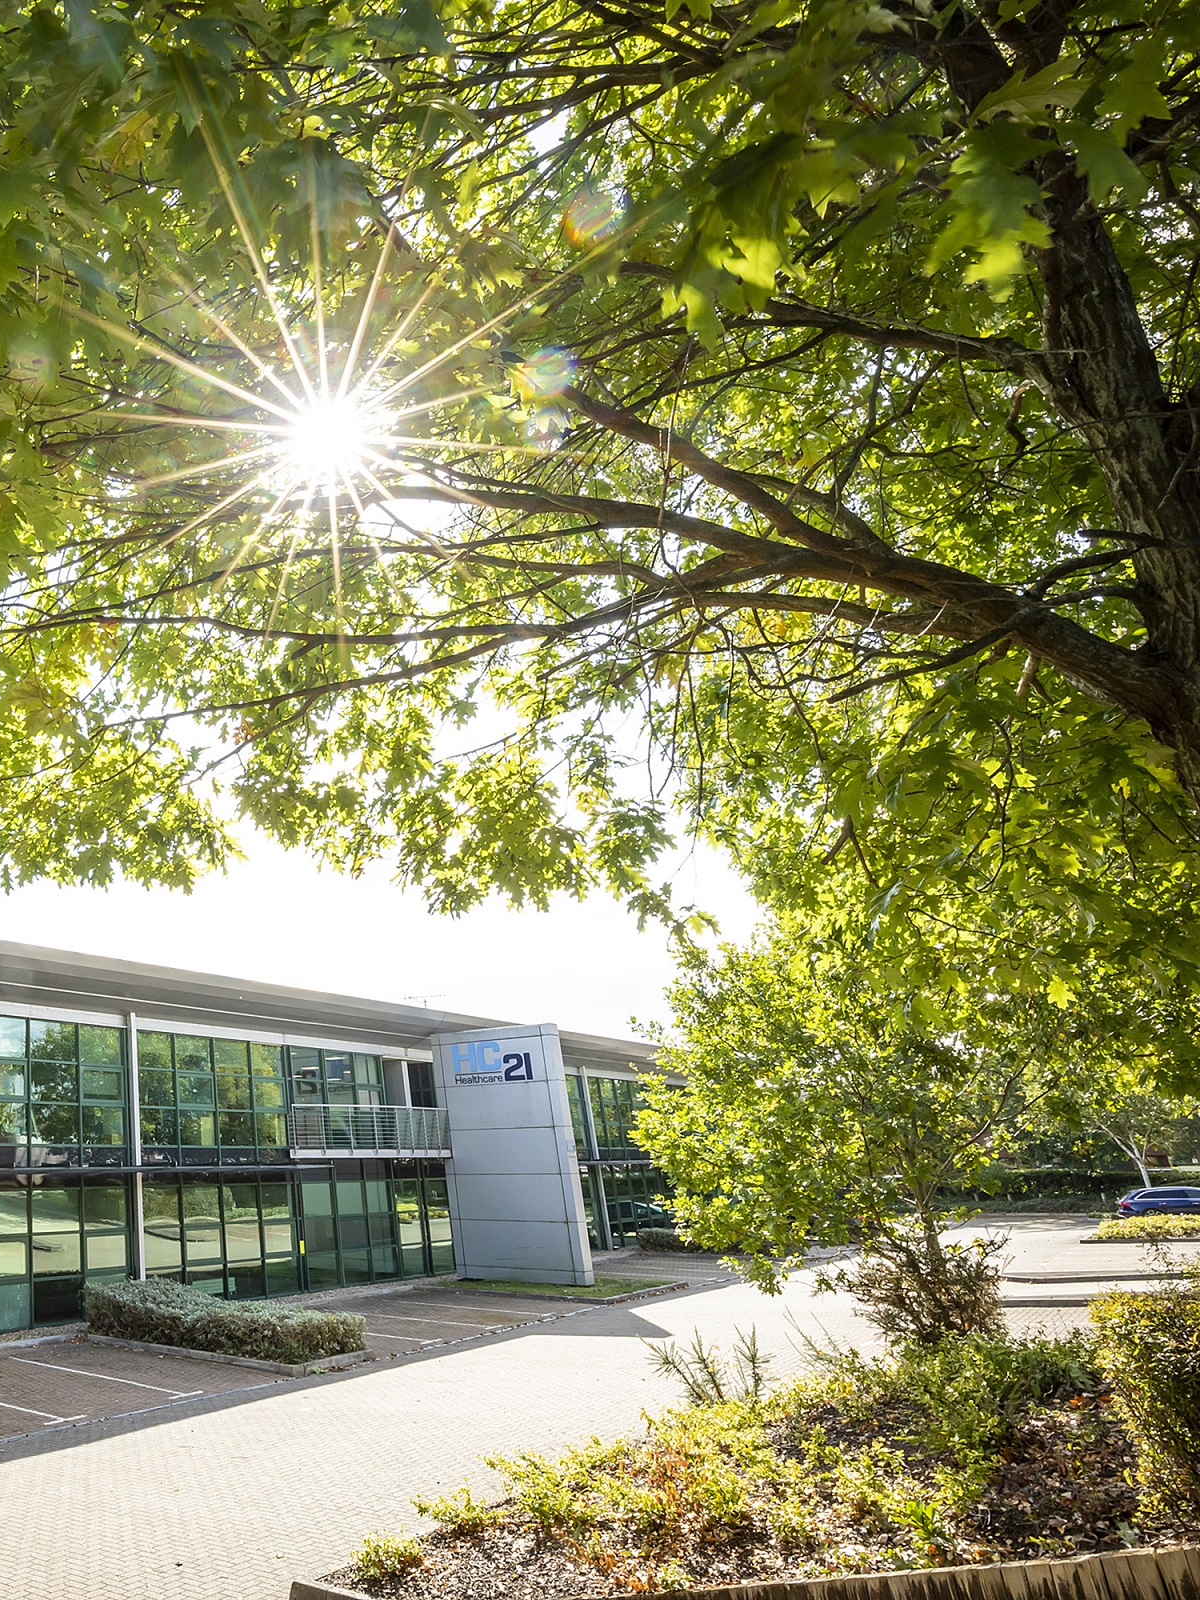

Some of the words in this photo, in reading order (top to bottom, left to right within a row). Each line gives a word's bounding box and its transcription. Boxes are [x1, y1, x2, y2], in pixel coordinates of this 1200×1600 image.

[451, 1040, 501, 1073] HC
[503, 1052, 533, 1081] 21
[455, 1074, 504, 1085] Healthcare
